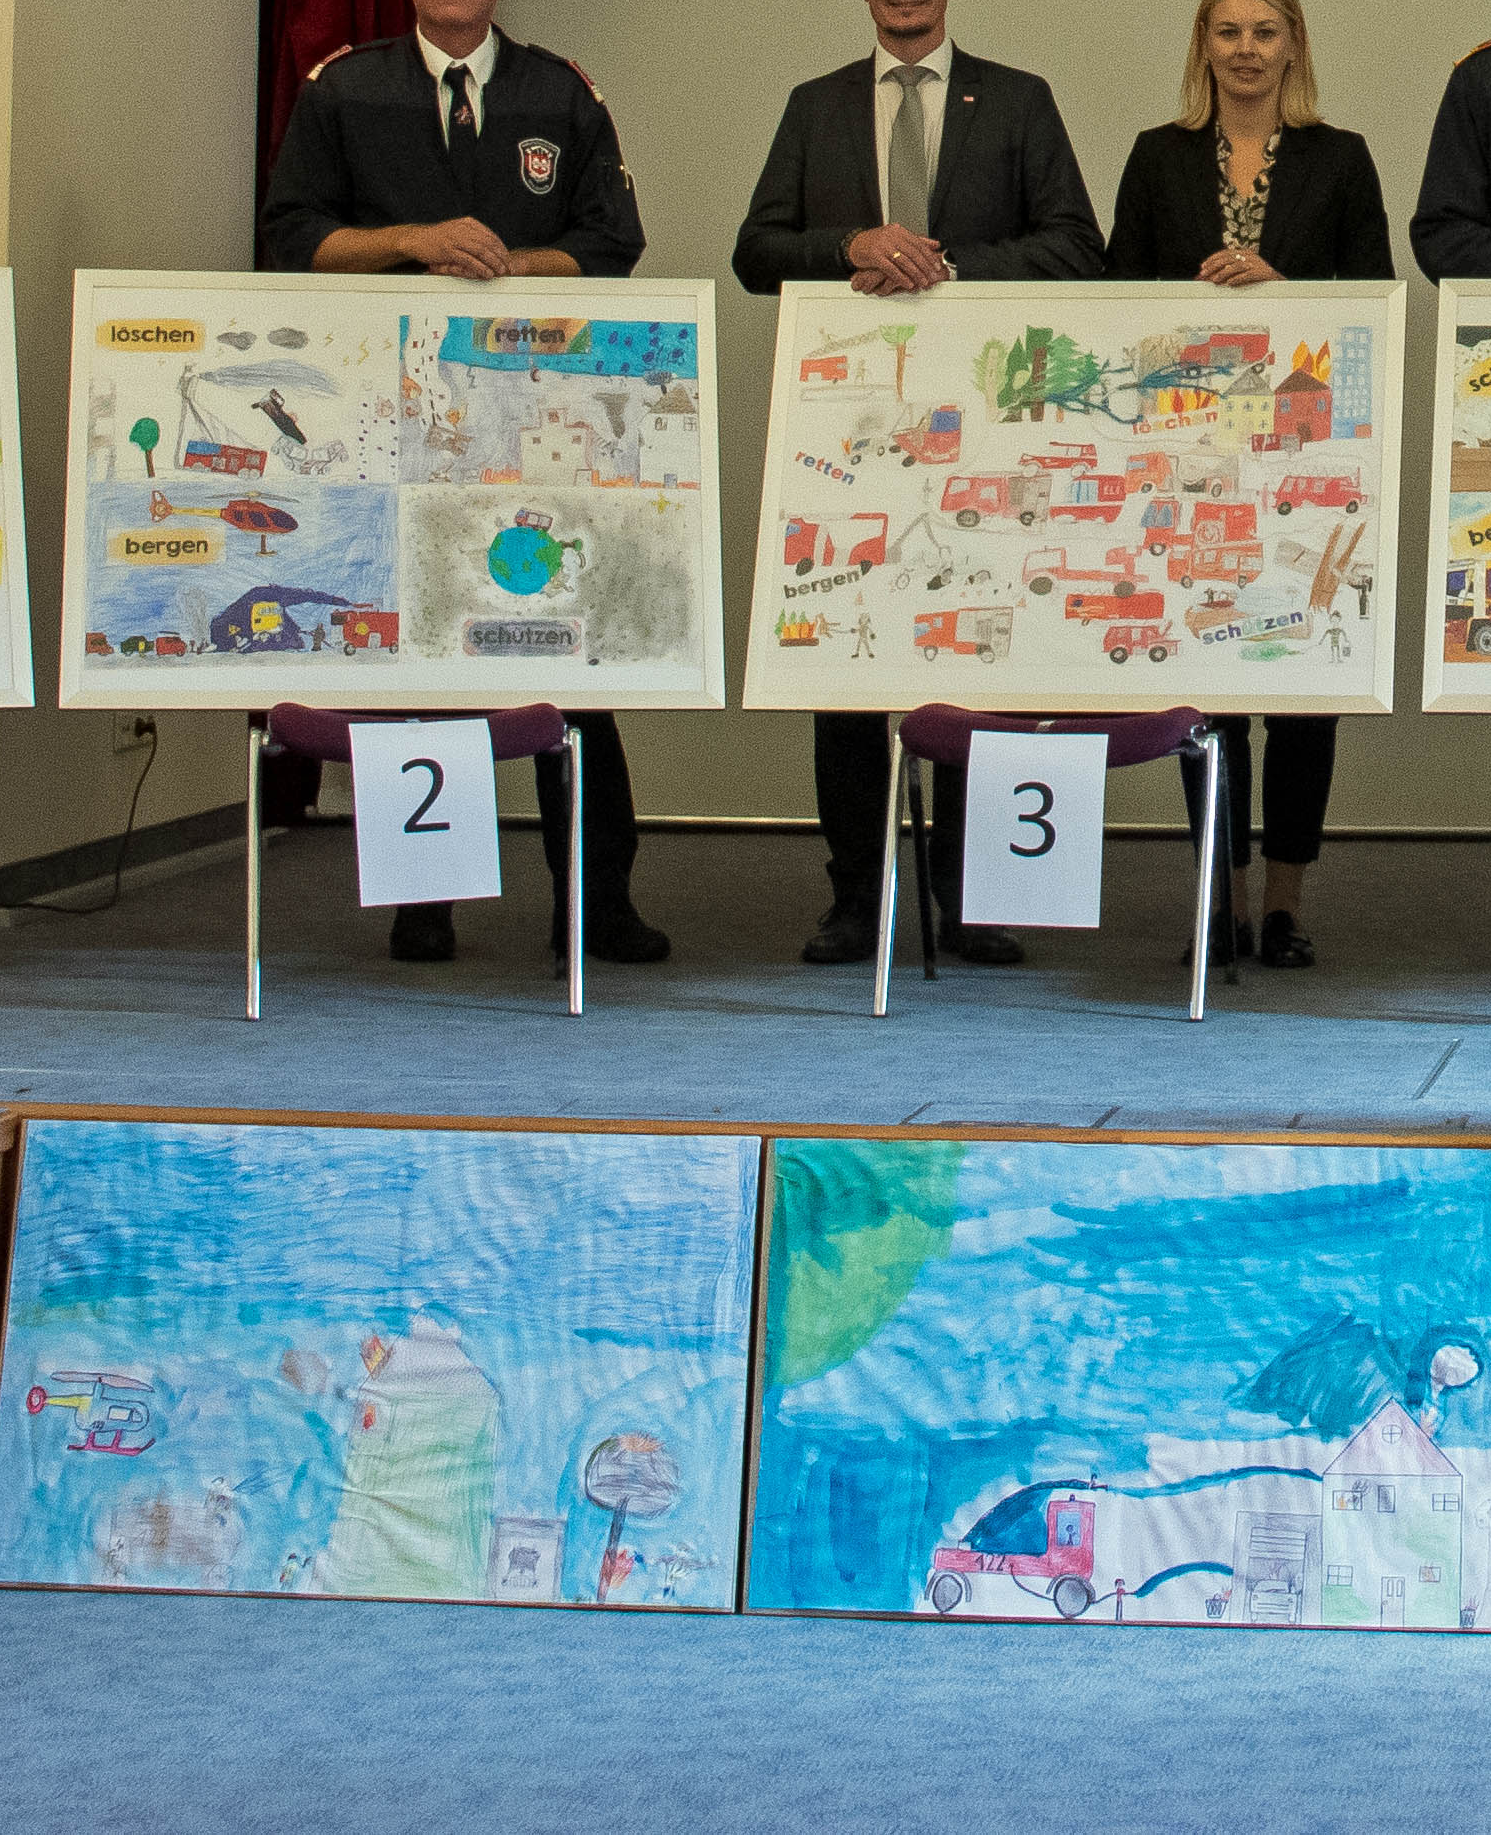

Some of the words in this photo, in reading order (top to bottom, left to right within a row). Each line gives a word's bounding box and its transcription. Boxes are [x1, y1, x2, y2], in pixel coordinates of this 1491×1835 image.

[111, 325, 195, 344] löschen
[495, 326, 565, 343] retten
[795, 451, 855, 485] retten
[124, 536, 209, 559] bergen
[784, 570, 860, 599] bergen
[402, 759, 450, 834] 2
[1010, 782, 1056, 858] 3
[975, 1553, 1006, 1572] 122
